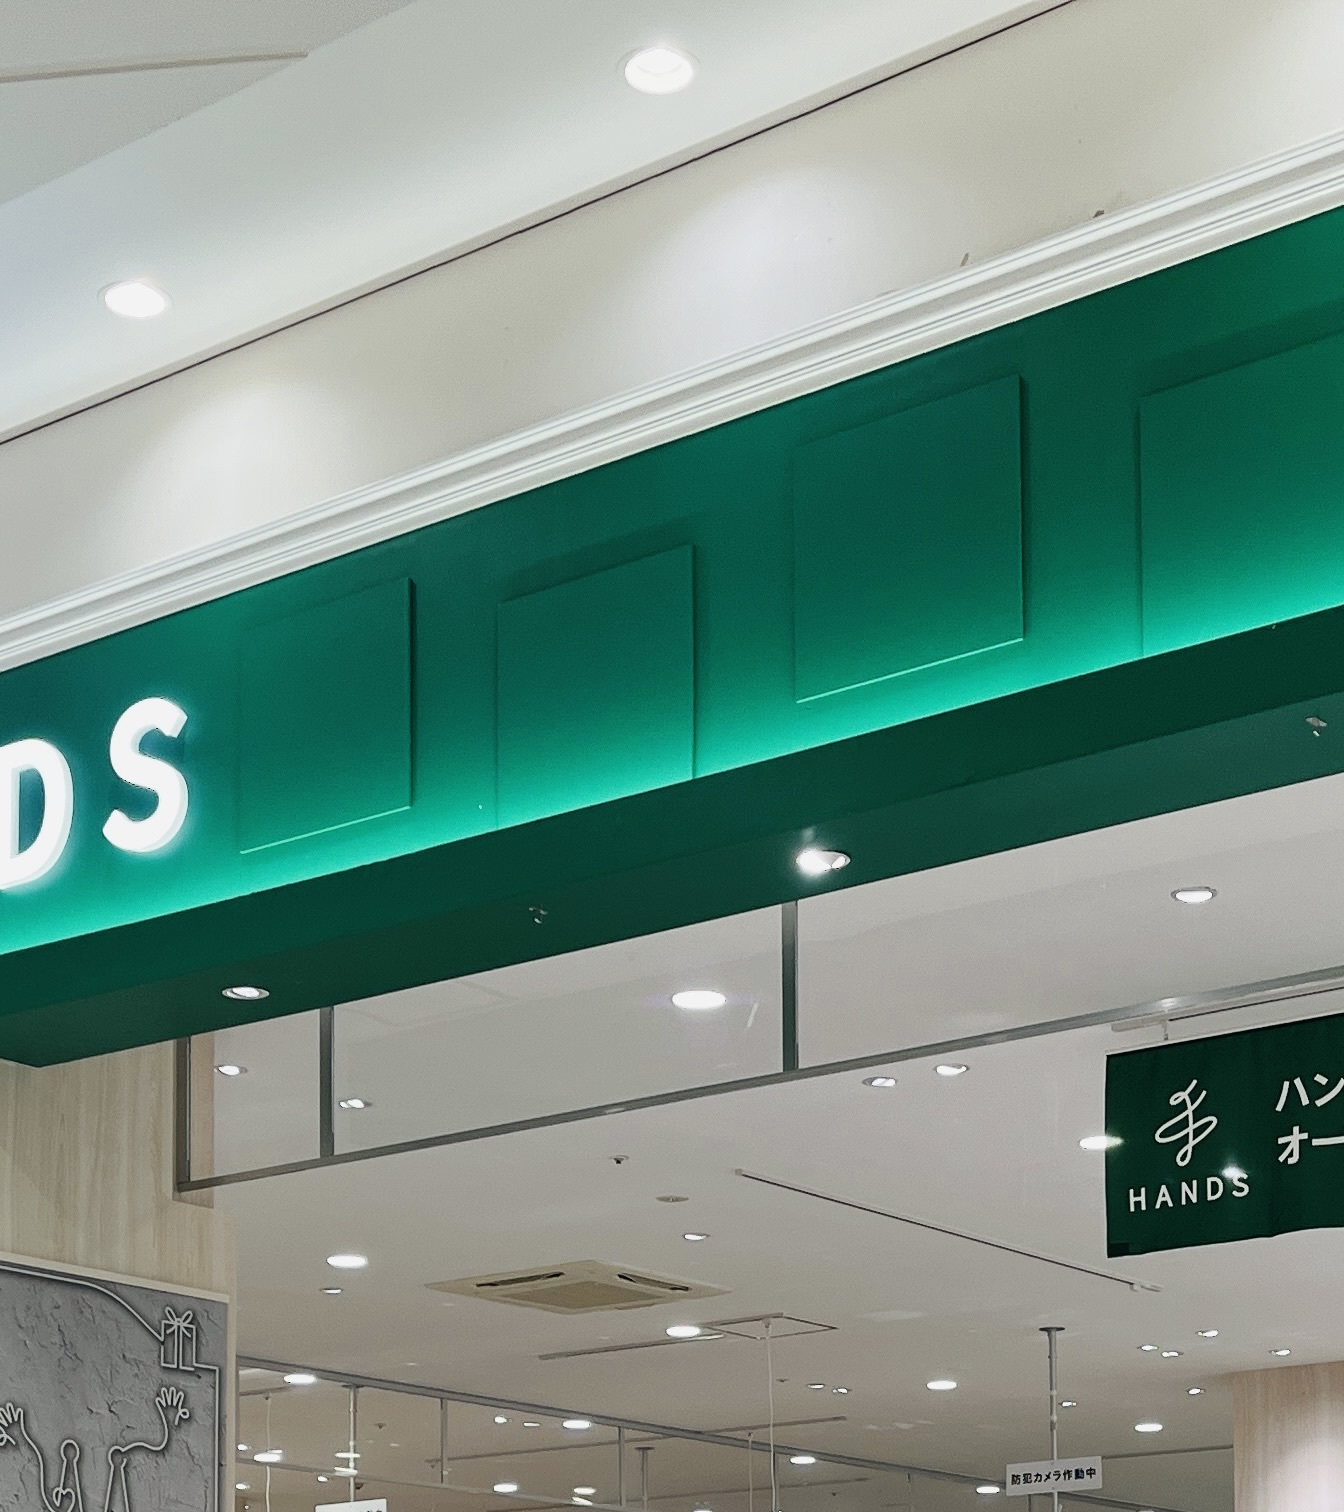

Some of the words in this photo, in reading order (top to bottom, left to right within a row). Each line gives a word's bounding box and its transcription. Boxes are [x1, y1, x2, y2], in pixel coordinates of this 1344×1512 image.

[1129, 1173, 1249, 1212] HANDS
[1010, 1466, 1097, 1486] 防犯カメラ作動中
